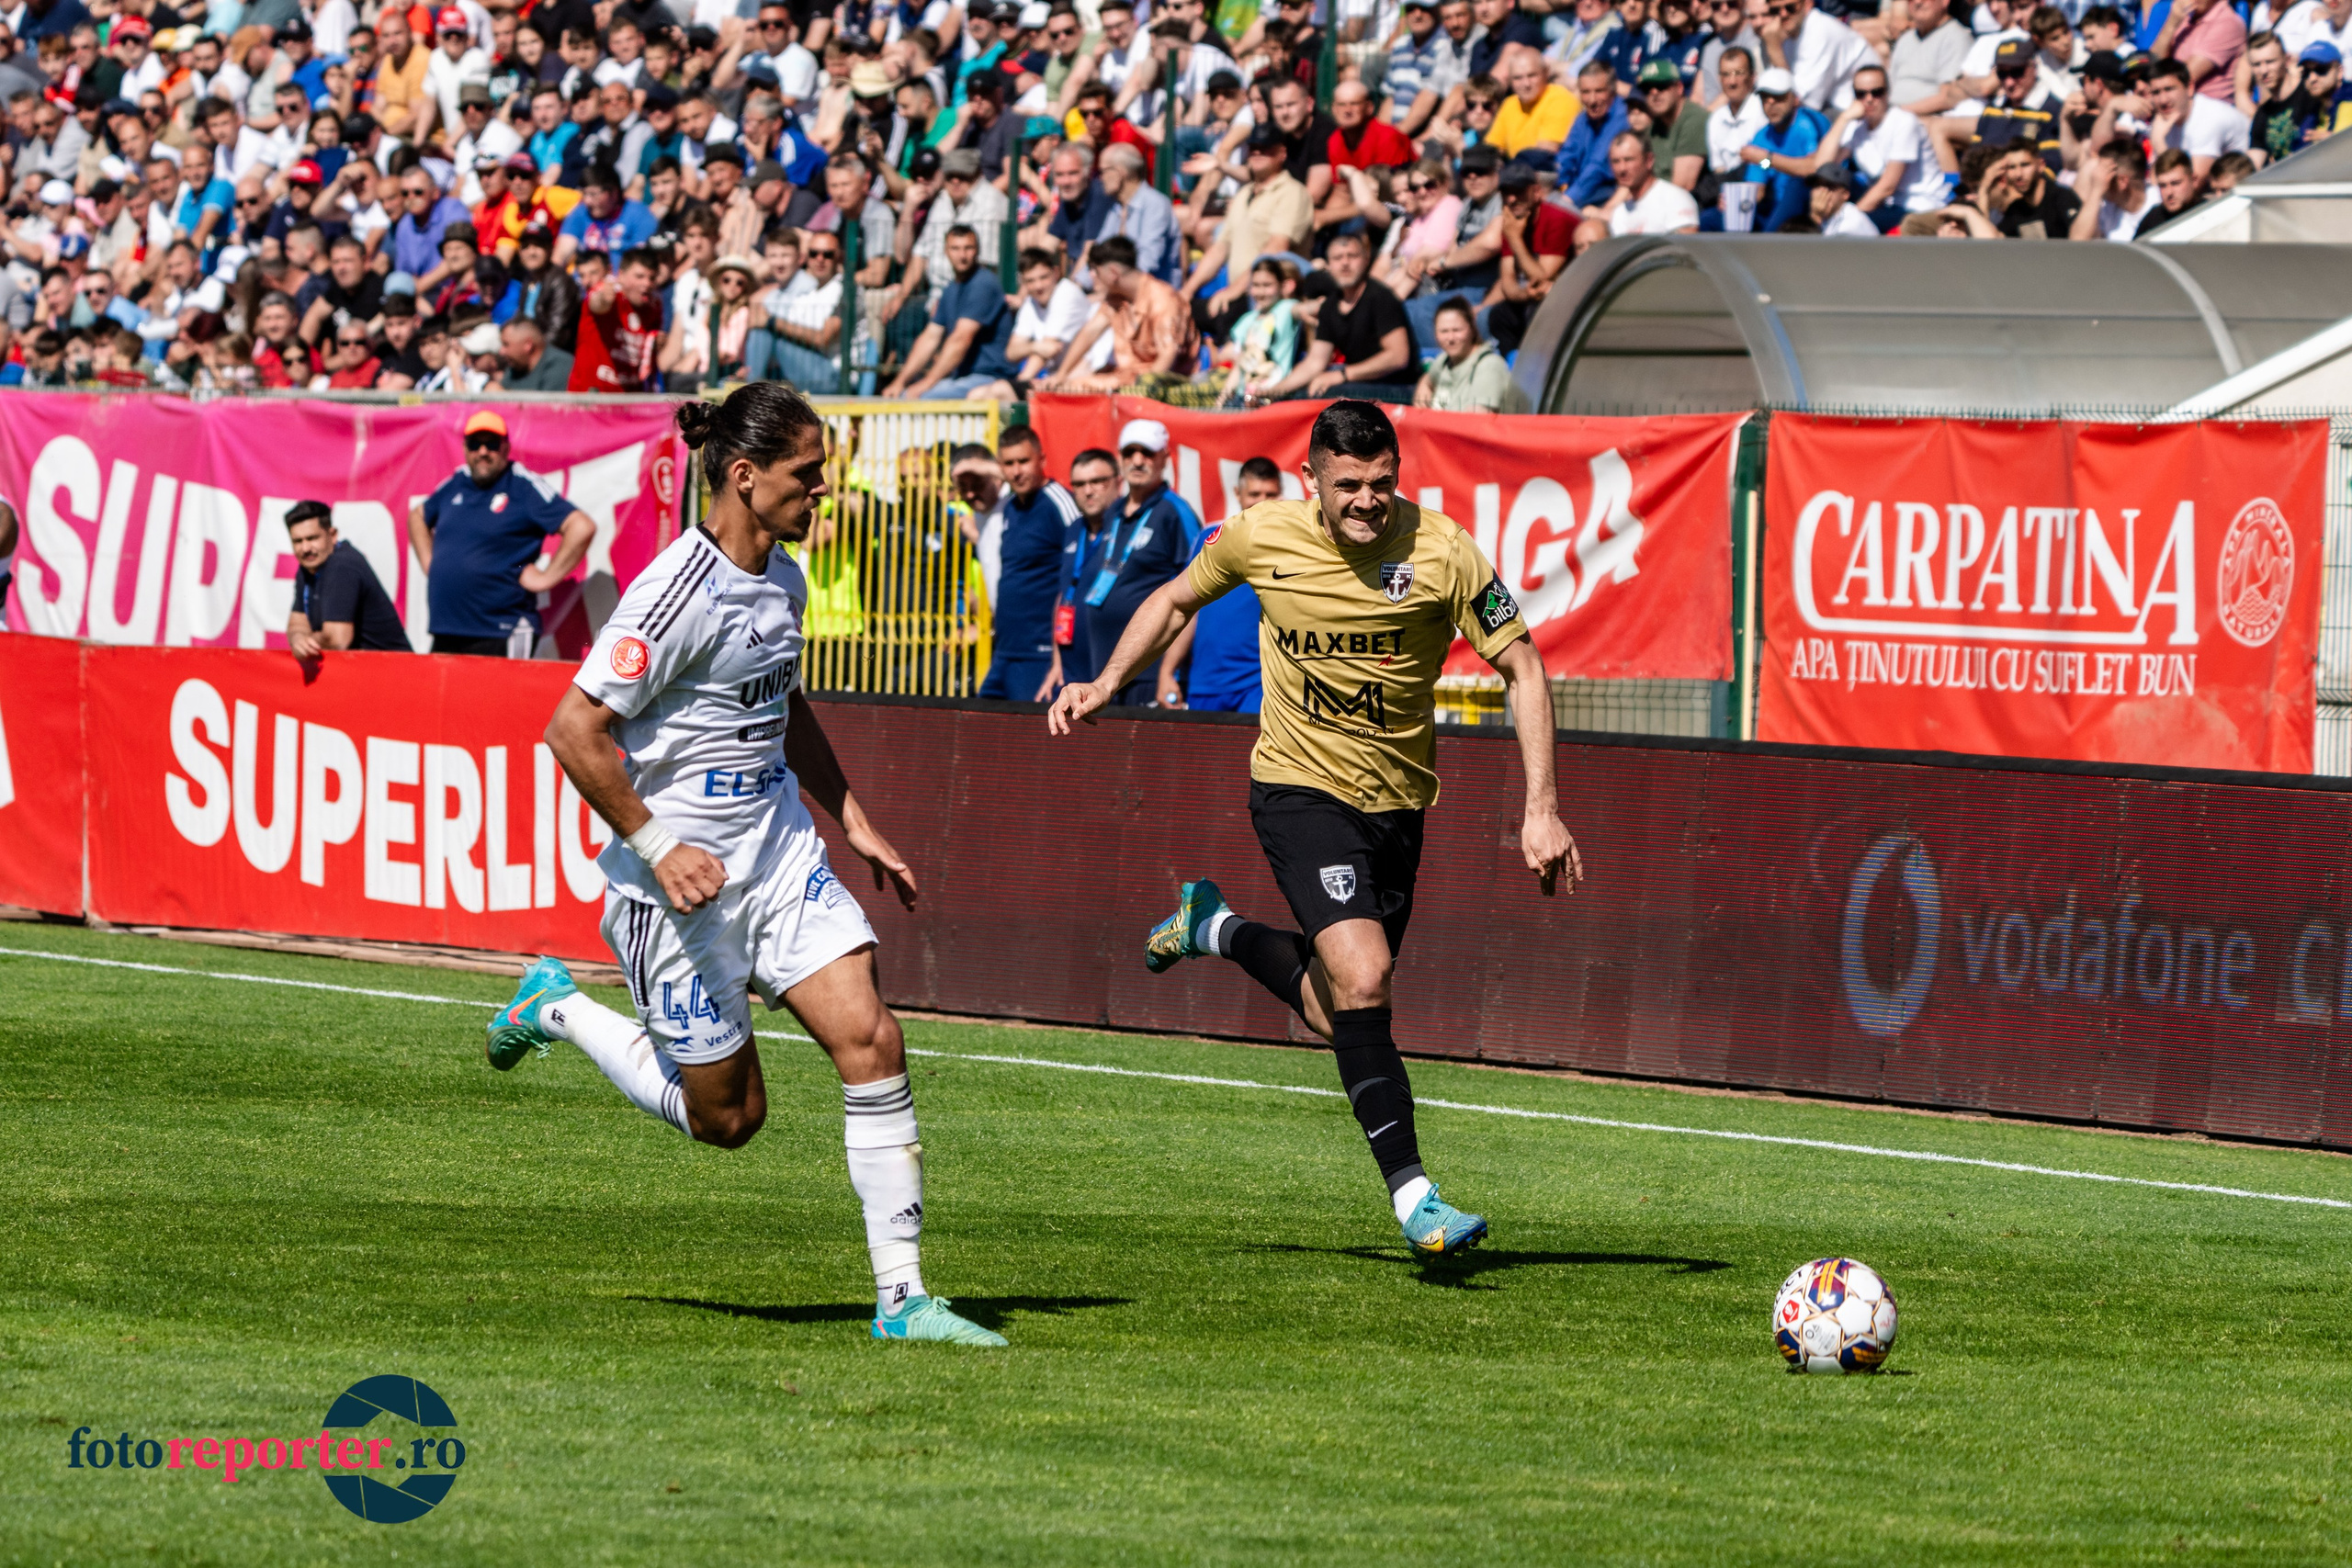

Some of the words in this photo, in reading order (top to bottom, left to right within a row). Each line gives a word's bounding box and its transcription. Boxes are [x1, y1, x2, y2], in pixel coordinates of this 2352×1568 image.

[1792, 490, 2199, 646] CARPATINA
[1277, 626, 1406, 656] MAXBET
[1791, 637, 1839, 681] APA
[1990, 647, 2032, 692] CU
[2033, 649, 2132, 695] SUFLET
[2138, 653, 2198, 696] BUN
[164, 678, 614, 914] SUPERLIG
[806, 880, 820, 899] FIVE
[1961, 889, 2257, 1012] vodafone
[663, 974, 720, 1030] 44
[705, 1021, 742, 1046] Vestra
[890, 1215, 922, 1224] adid
